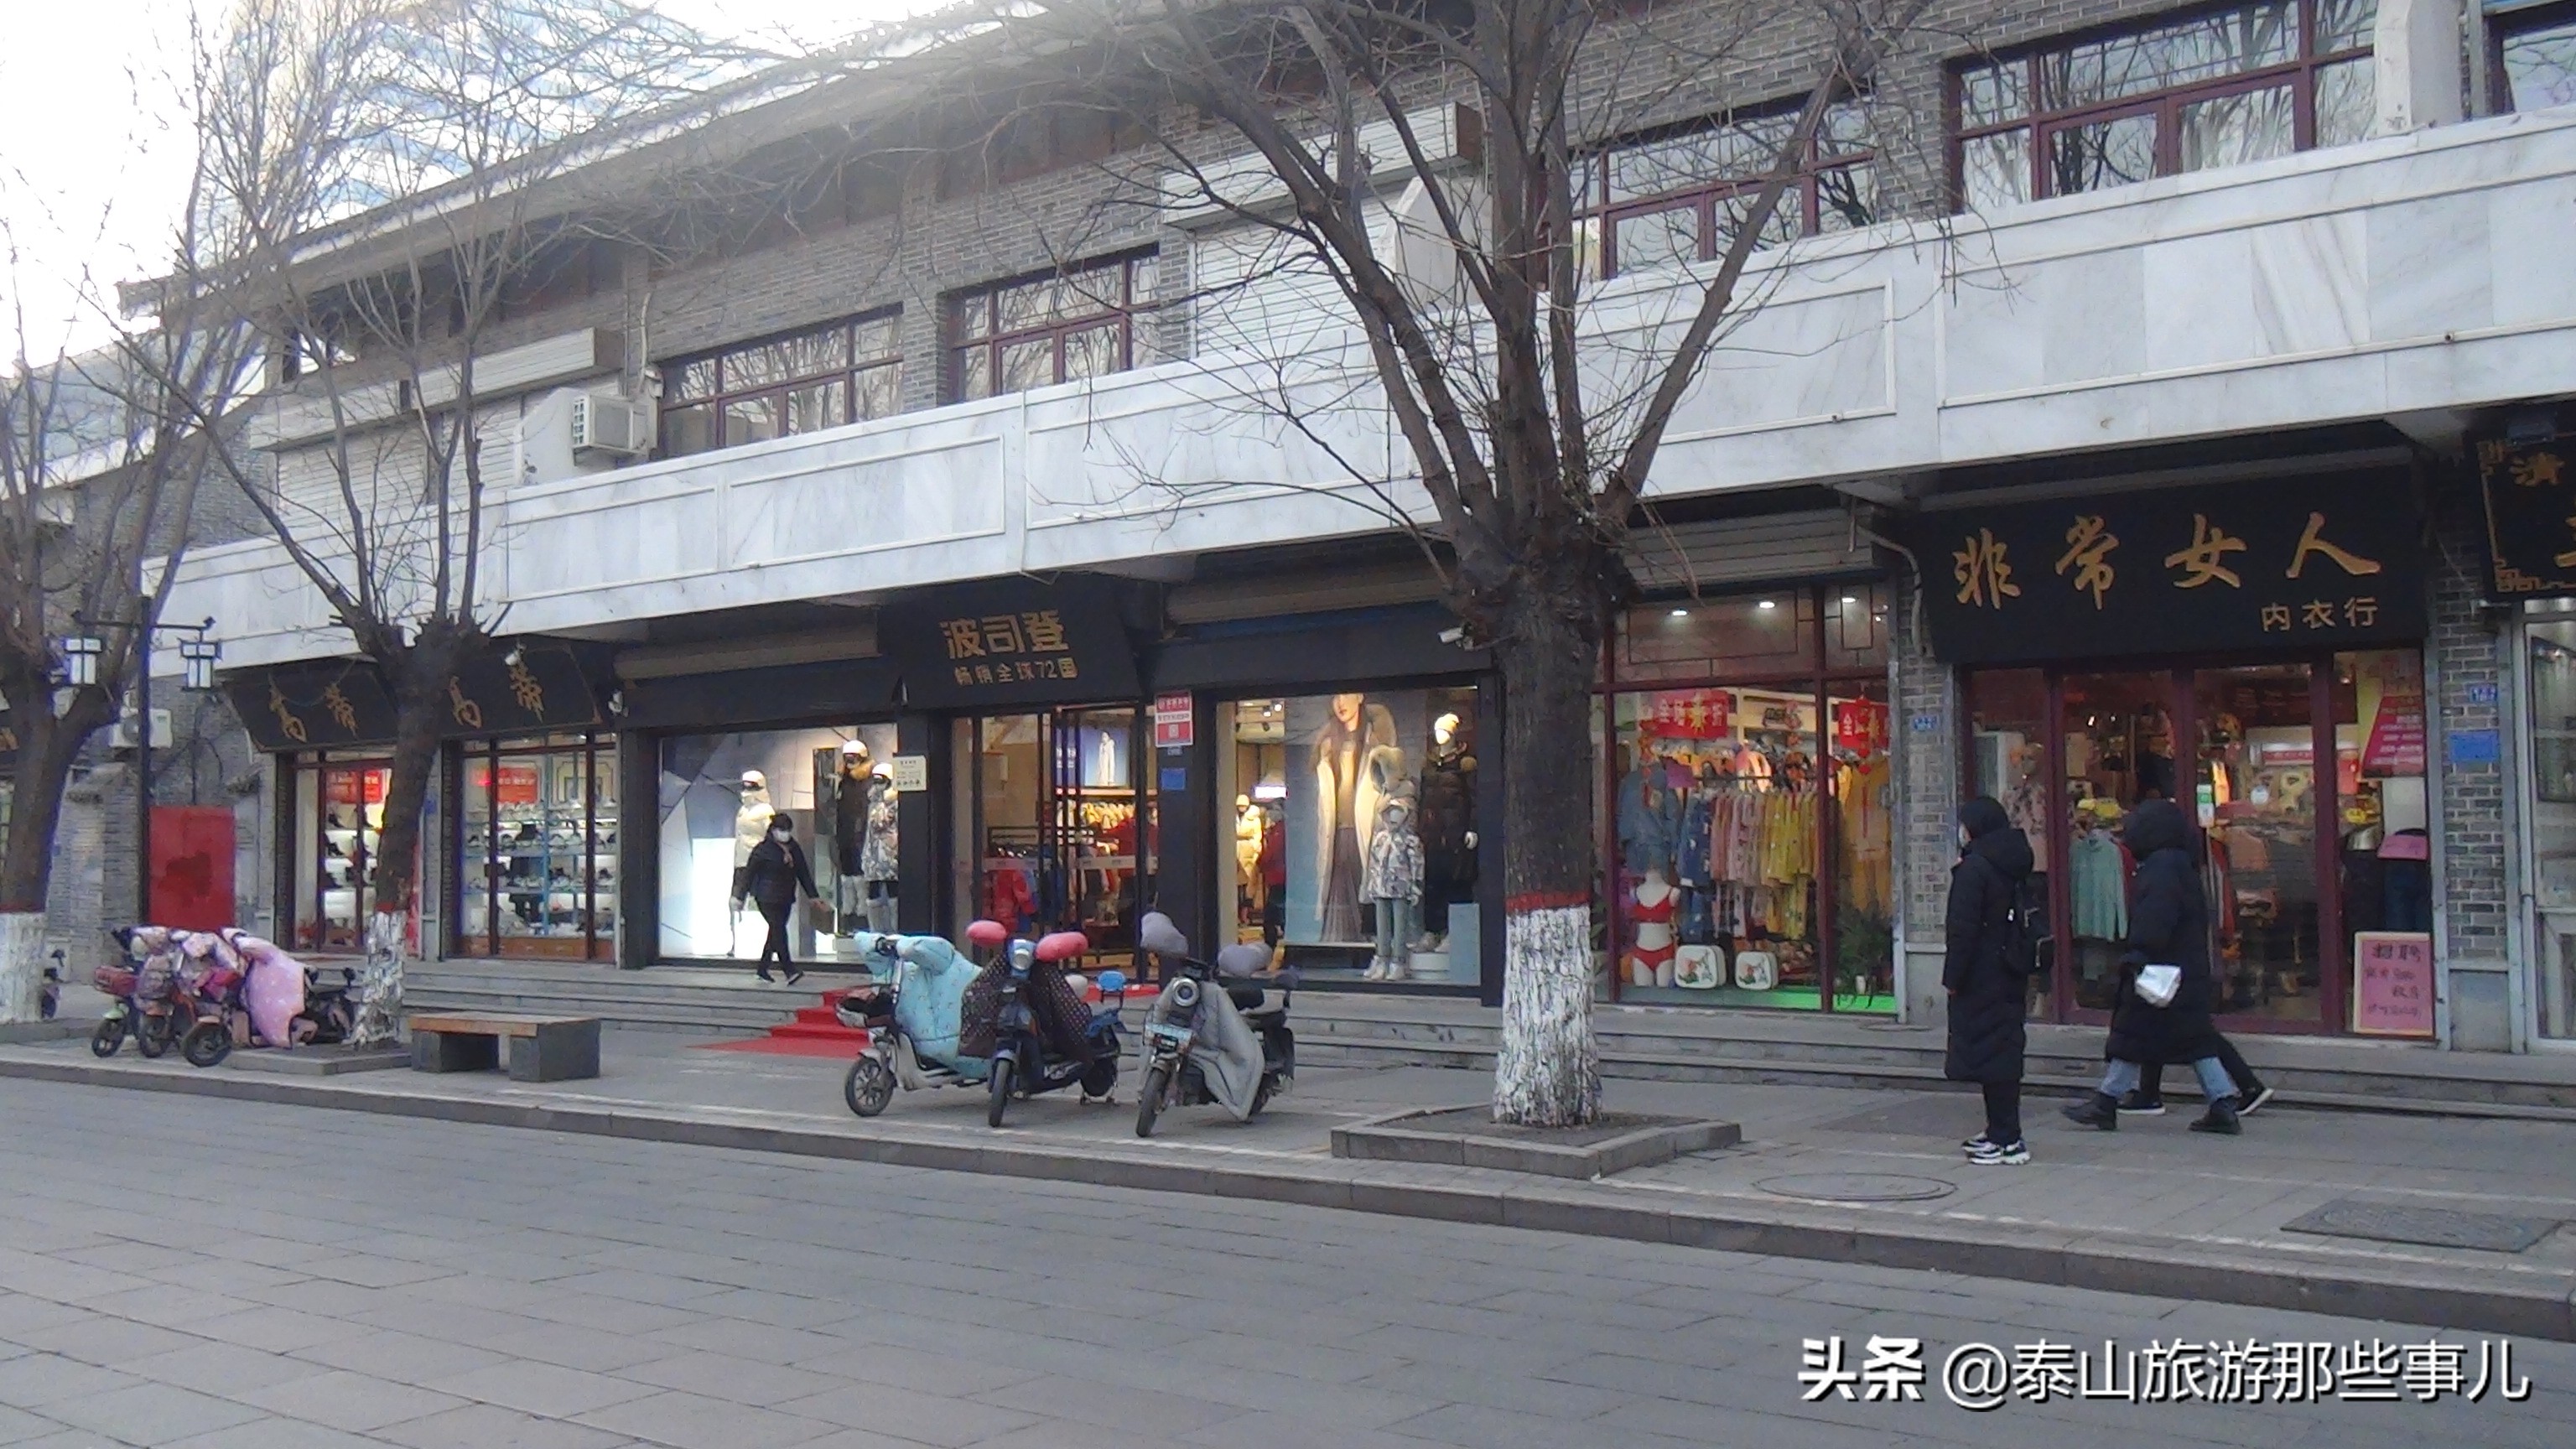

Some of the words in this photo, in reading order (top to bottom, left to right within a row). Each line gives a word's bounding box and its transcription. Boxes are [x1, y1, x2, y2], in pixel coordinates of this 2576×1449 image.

[1951, 510, 2381, 611] 非常女人
[938, 609, 1070, 659] 波司登
[2260, 595, 2379, 631] 内衣行
[953, 657, 1078, 686] 畅销全球72国
